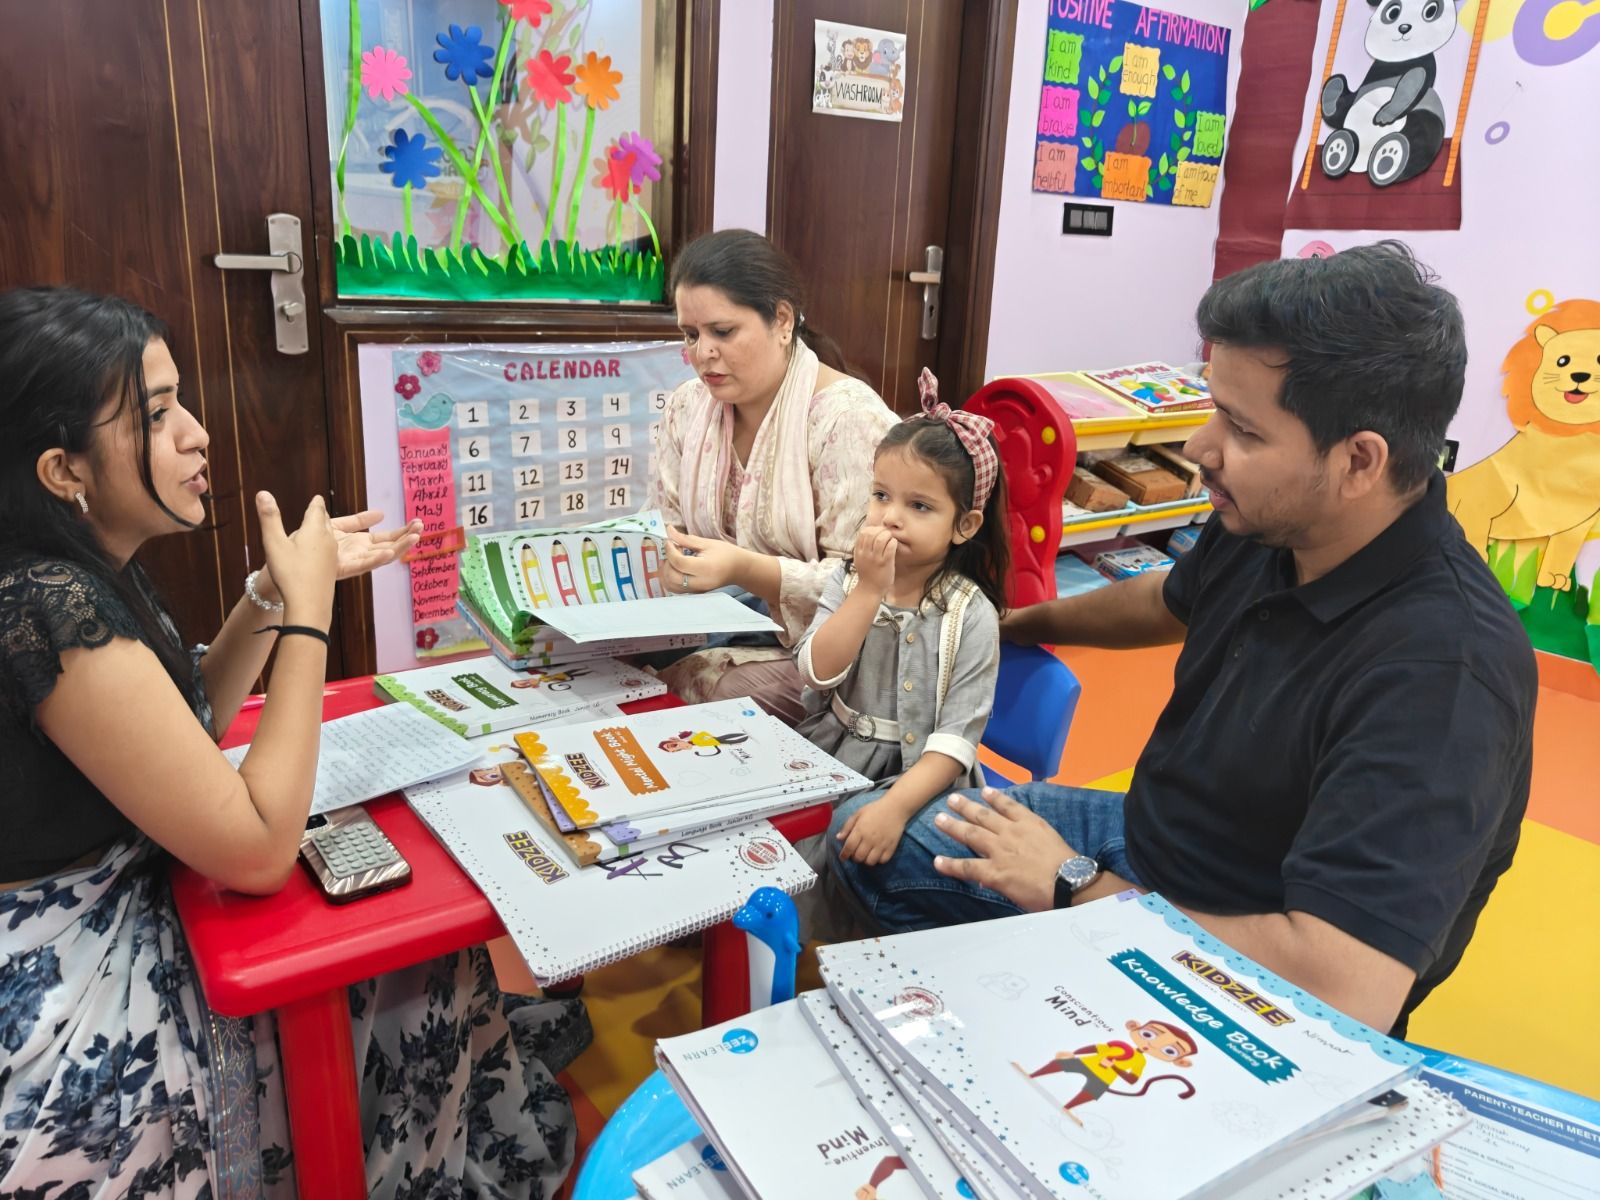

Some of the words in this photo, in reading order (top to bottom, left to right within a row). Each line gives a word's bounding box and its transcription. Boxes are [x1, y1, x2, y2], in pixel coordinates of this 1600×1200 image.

[1134, 6, 1227, 55] AFFIRMATION
[1060, 40, 1077, 53] am
[1048, 59, 1071, 80] kind
[1132, 54, 1149, 68] am
[1122, 67, 1157, 97] enough
[835, 81, 883, 105] WASHROOM
[1053, 97, 1071, 110] am
[1042, 117, 1074, 133] brave
[1204, 119, 1220, 132] am
[1048, 148, 1066, 162] am
[1113, 158, 1129, 169] am
[1185, 188, 1199, 201] me
[503, 359, 621, 382] CALENDAR
[468, 407, 479, 423] 1
[518, 405, 530, 420] 2
[566, 401, 576, 416] 3
[610, 397, 620, 412] 4
[655, 393, 666, 409] 5
[400, 443, 448, 460] January
[468, 441, 480, 457] 6
[519, 436, 531, 453] 7
[567, 430, 577, 448] 8
[611, 427, 621, 445] 9
[401, 458, 448, 474] February
[467, 474, 485, 492] 11
[519, 469, 541, 487] 12
[563, 463, 585, 480] 13
[611, 457, 630, 475] 14
[408, 472, 445, 488] March
[412, 486, 449, 502] April
[415, 502, 443, 518] May
[468, 506, 488, 527] 16
[519, 499, 540, 518] 17
[566, 493, 585, 511] 18
[608, 487, 626, 506] 19
[423, 520, 445, 531] une
[411, 561, 457, 579] September
[413, 577, 449, 593] October
[413, 591, 458, 607] November
[414, 605, 455, 622] December
[424, 688, 471, 712] KIDZEE
[600, 731, 621, 748] Book
[614, 748, 639, 767] Might
[564, 751, 610, 790] KIDZEE
[628, 766, 659, 789] Mental
[503, 829, 569, 885] KIDZEE
[1171, 949, 1296, 1027] KIDZEE
[1044, 995, 1092, 1027] Mind
[1054, 985, 1114, 1033] Conscientious
[1120, 956, 1225, 1031] Knowledge
[1225, 1030, 1284, 1070] Book
[1226, 1043, 1260, 1067] Nursery
[1464, 1088, 1564, 1130] PARENT-TEACHER
[816, 1125, 870, 1160] Mind
[833, 1136, 890, 1165] Inventive
